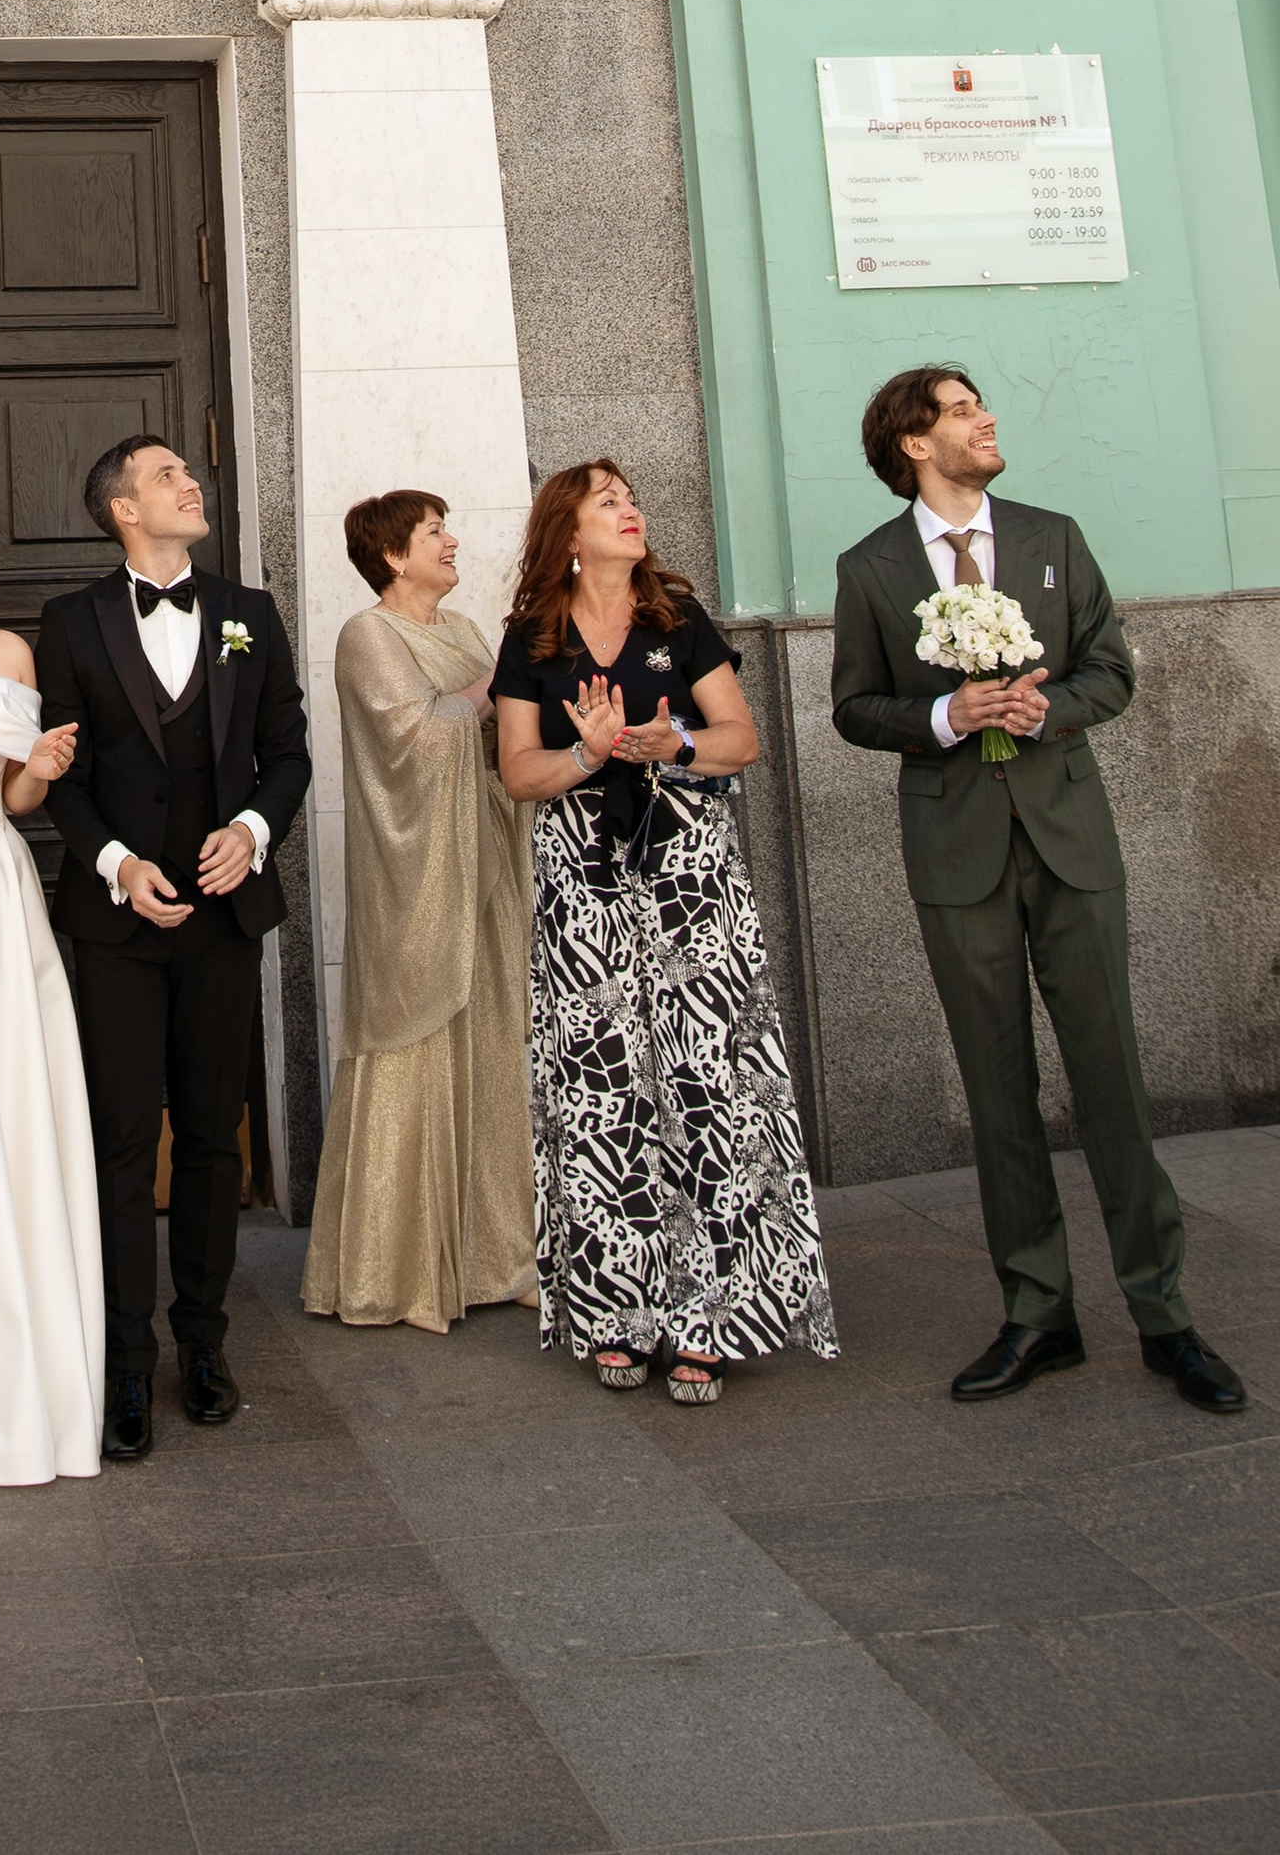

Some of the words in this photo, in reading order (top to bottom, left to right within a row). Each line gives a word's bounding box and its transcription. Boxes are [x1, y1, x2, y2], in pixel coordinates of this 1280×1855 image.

[868, 118, 922, 133] Дворец
[924, 116, 1037, 133] бракосочетания
[1060, 115, 1067, 127] 1
[923, 151, 970, 163] РЕЖИМ
[972, 150, 1020, 162] РАБОТЫ
[1028, 168, 1056, 180] 9:00
[1067, 167, 1099, 179] 18:00
[1031, 187, 1059, 199] 9:00
[1067, 186, 1102, 198] 20:00
[1033, 207, 1061, 219] 9:00
[1070, 206, 1104, 218] 23:59
[1028, 227, 1063, 239] 00:00
[1074, 226, 1107, 238] 19:00
[899, 259, 931, 267] МОСКВЫ
